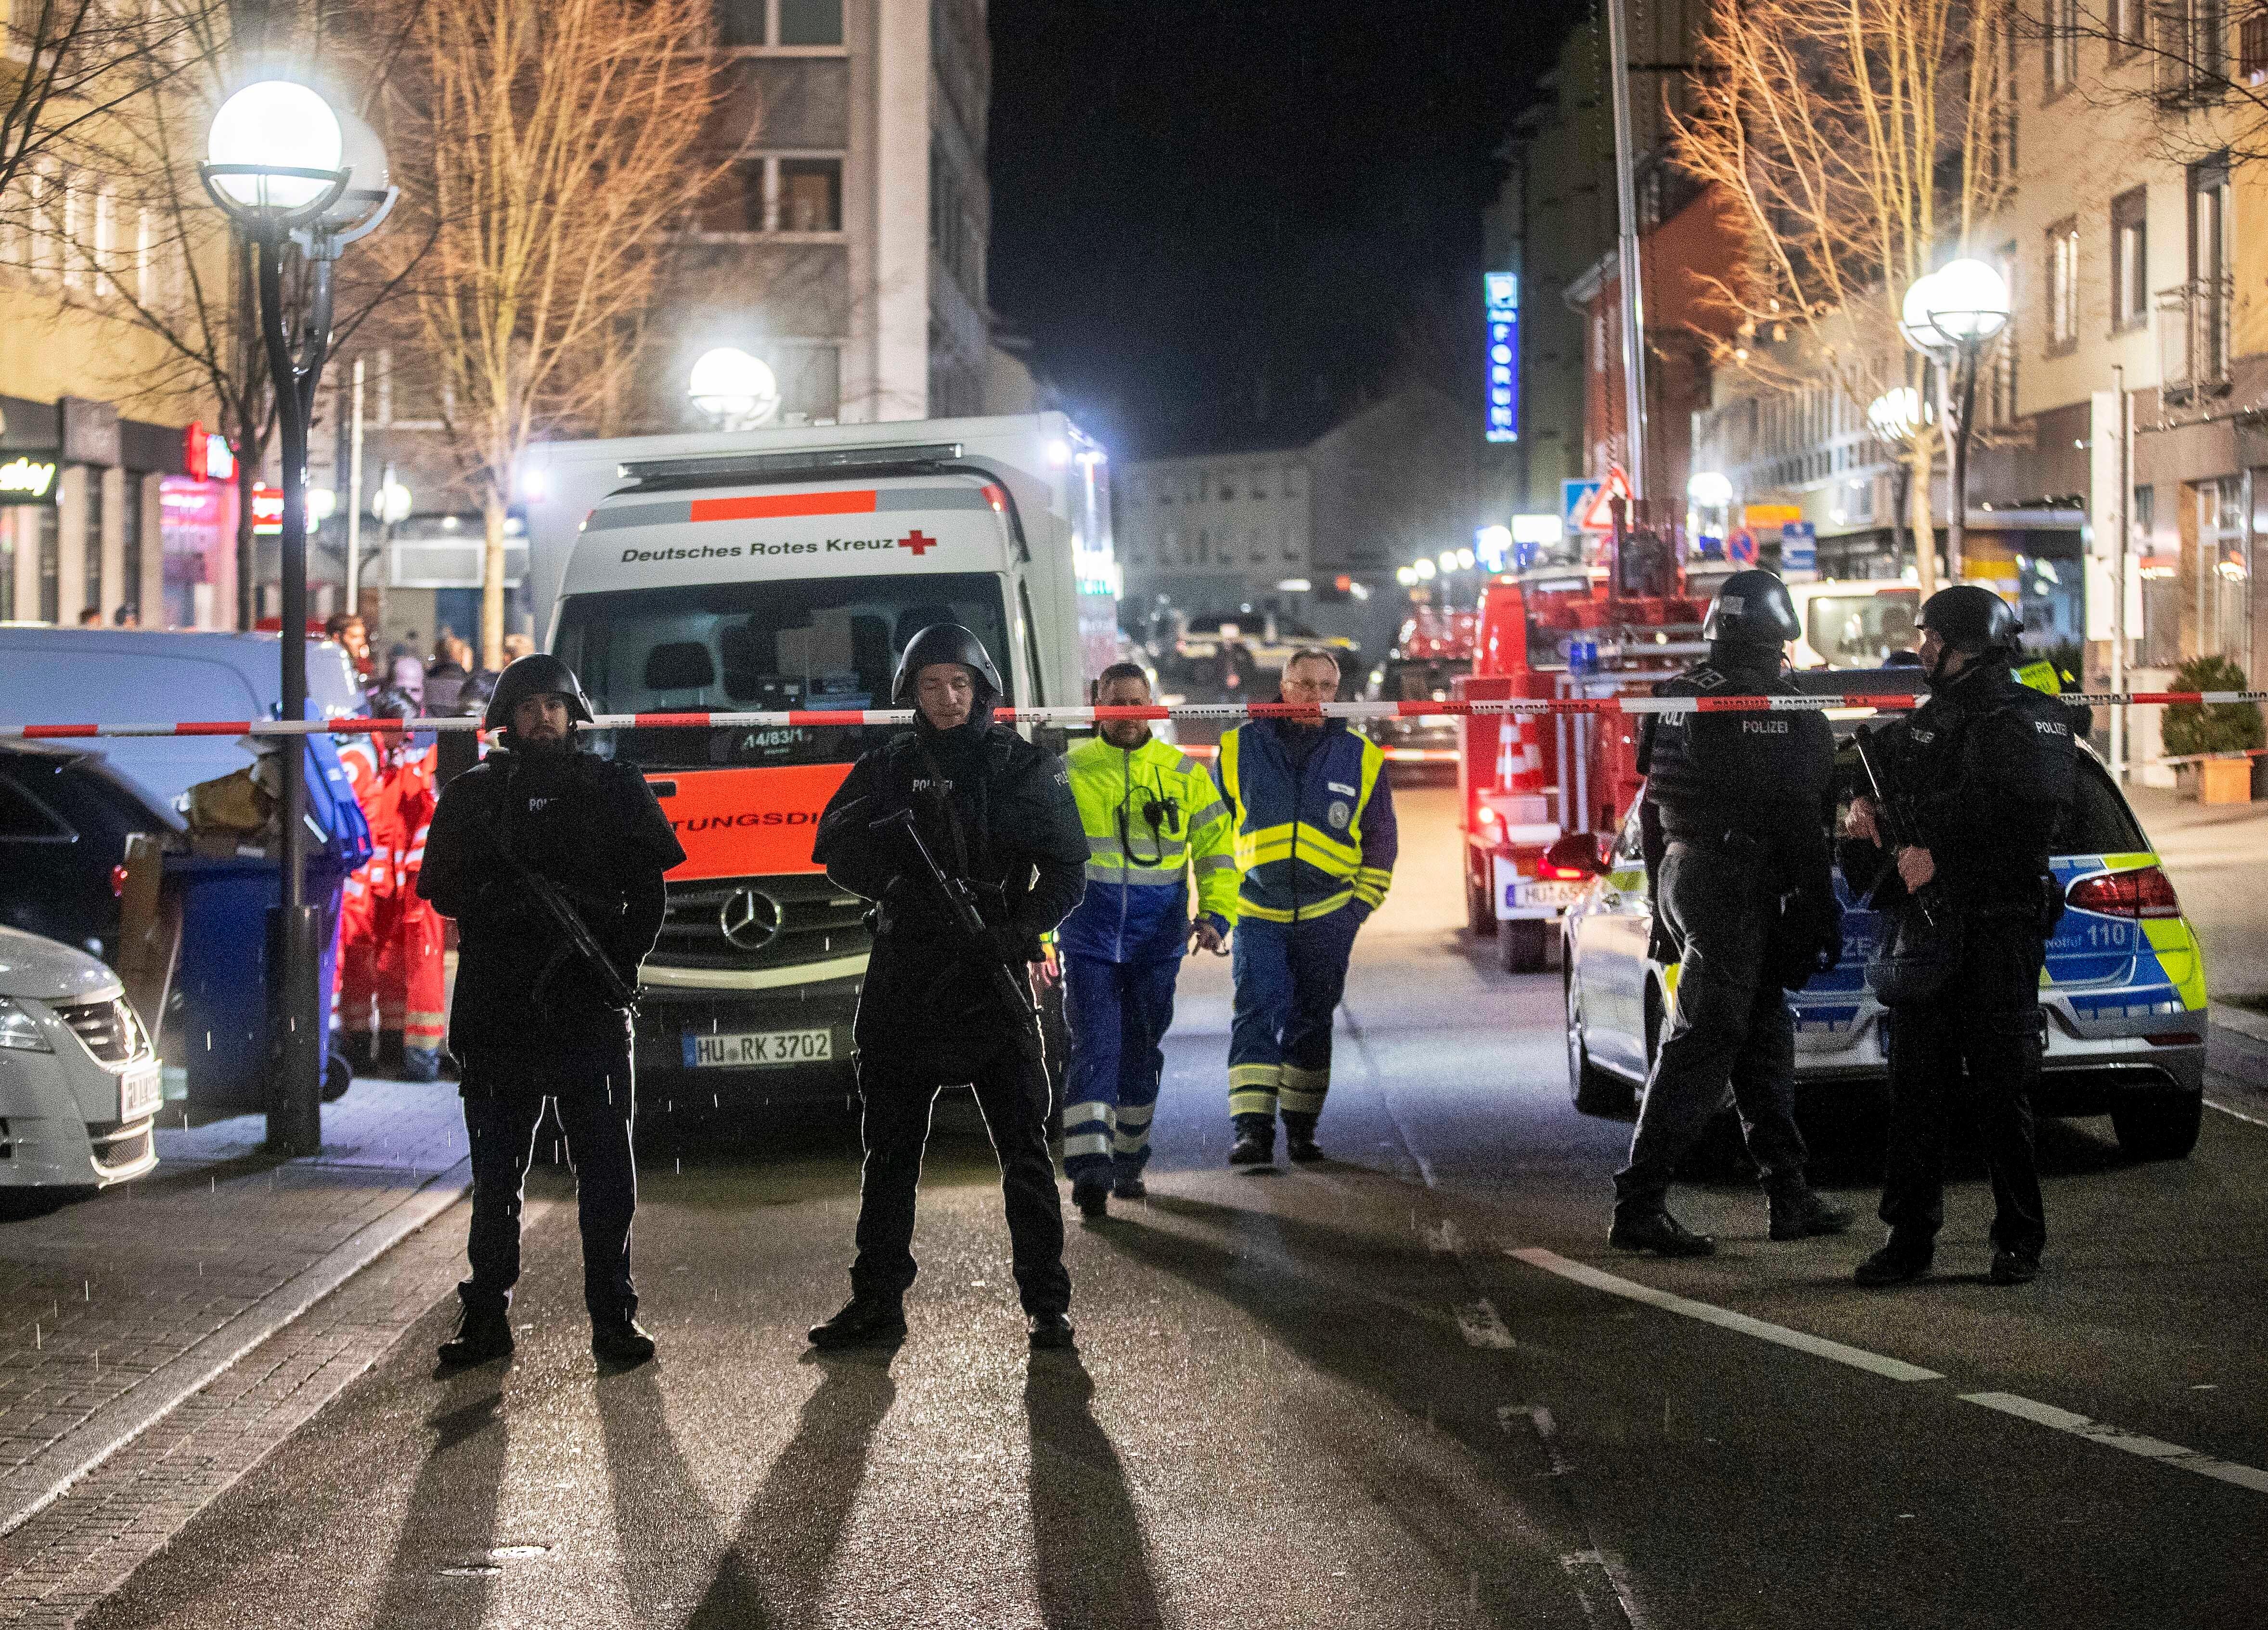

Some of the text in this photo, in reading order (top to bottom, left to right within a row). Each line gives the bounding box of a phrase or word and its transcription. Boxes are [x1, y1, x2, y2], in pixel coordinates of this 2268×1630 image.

[621, 537, 894, 564] Deutsches Rotes Kreuz
[1742, 721, 1789, 734] POLIZEI
[2087, 922, 2126, 946] 110
[697, 1033, 828, 1062] HU RK 3702
